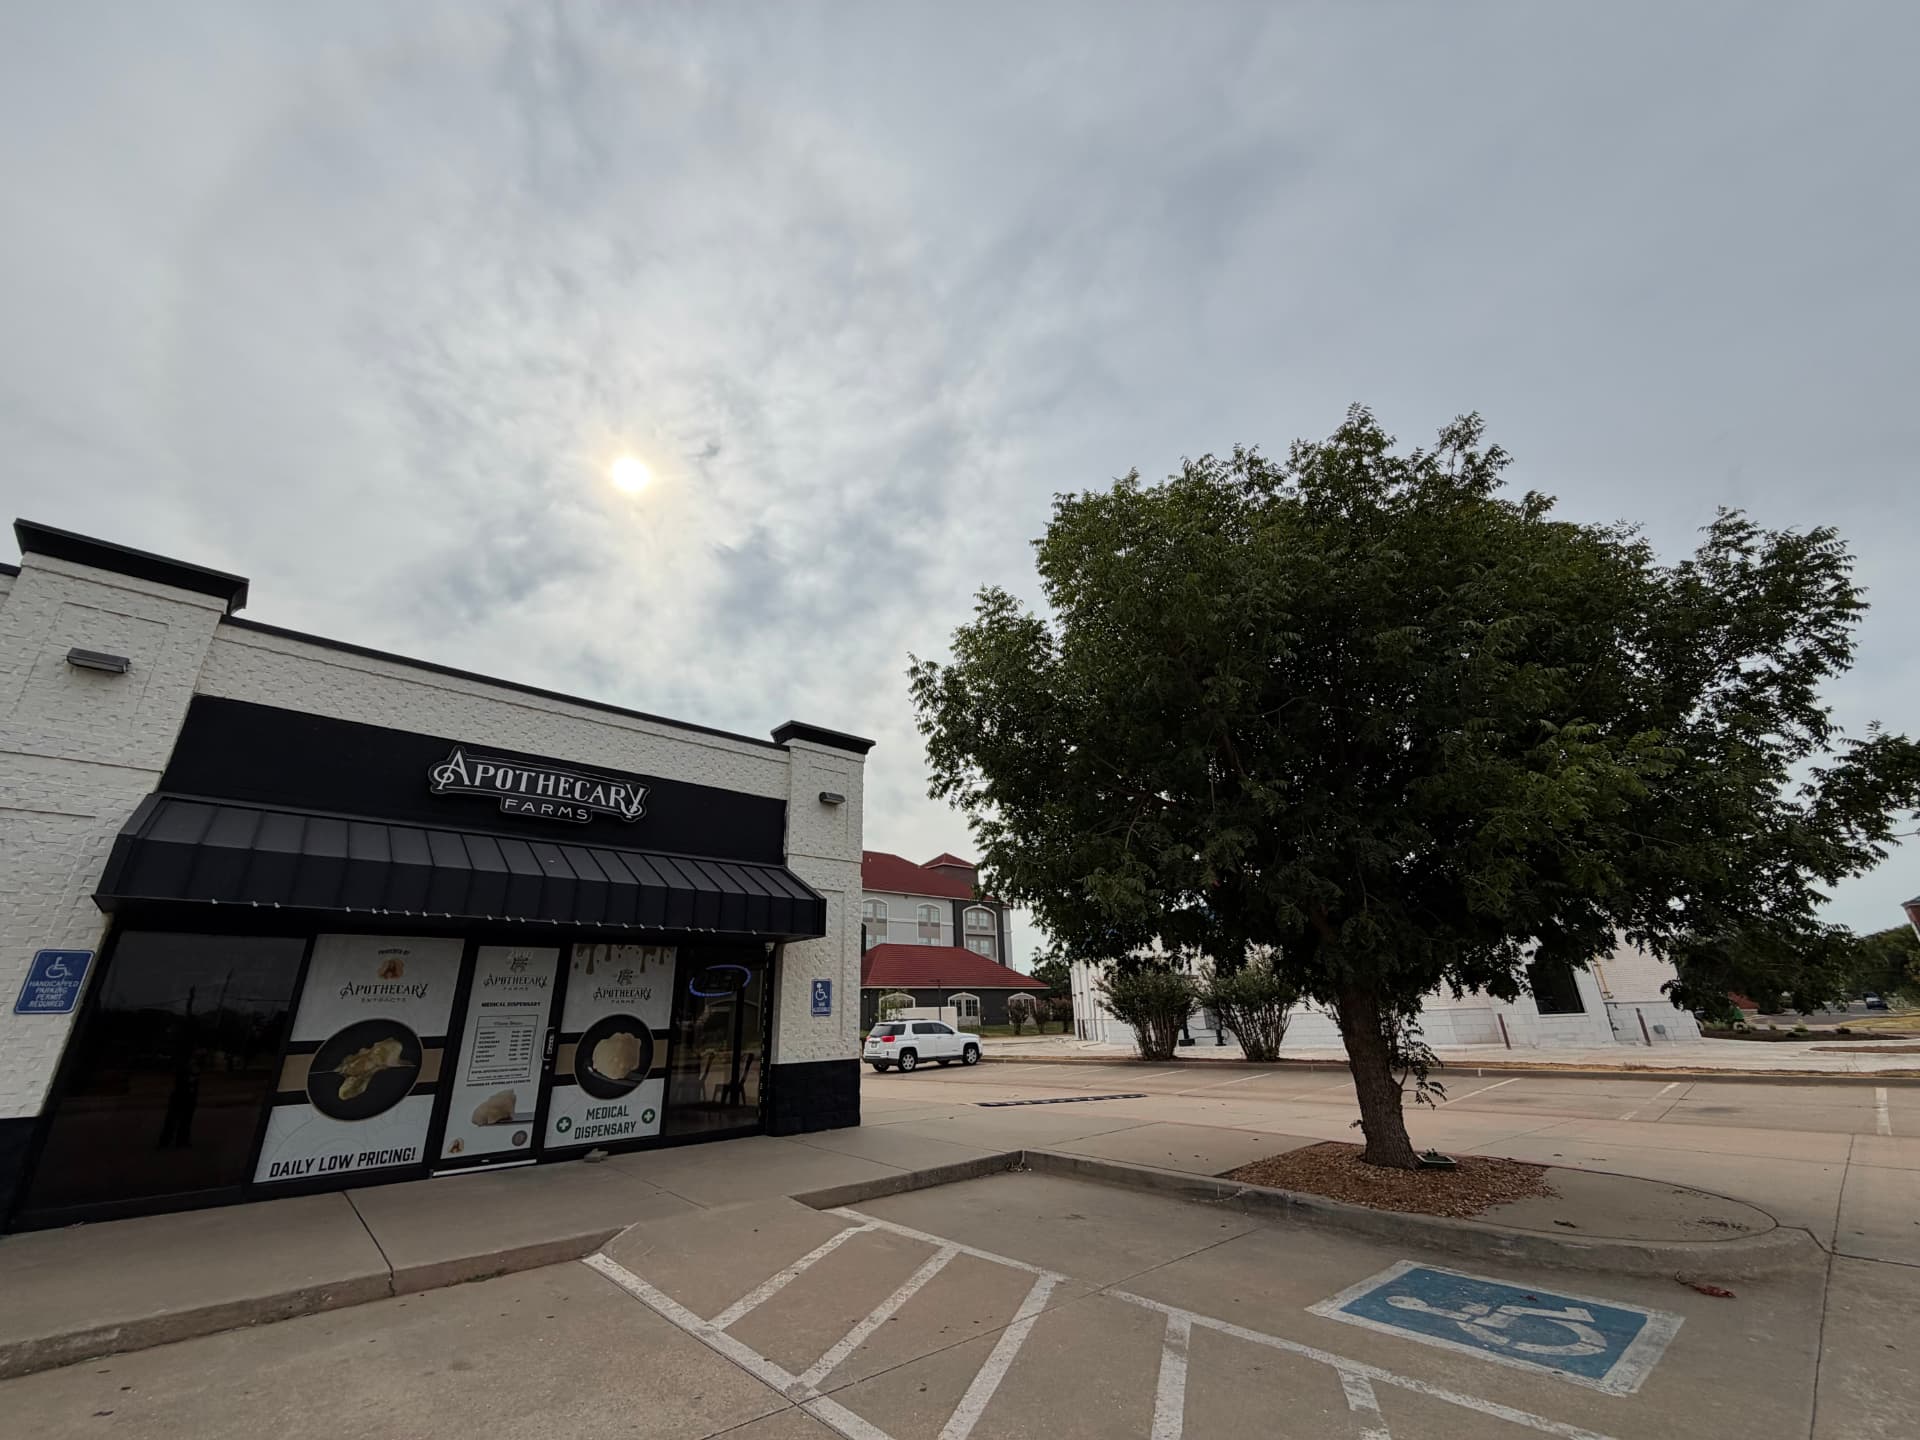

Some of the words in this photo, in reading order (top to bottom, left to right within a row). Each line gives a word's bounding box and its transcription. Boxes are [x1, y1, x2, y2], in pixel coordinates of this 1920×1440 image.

[433, 749, 647, 818] APOTHECARY
[504, 798, 589, 820] FARMS
[340, 980, 428, 999] APOTHECARY
[483, 972, 548, 989] APOTHECARY
[593, 986, 652, 1001] APOTHECARY
[585, 1105, 630, 1121] MEDICAL
[574, 1121, 637, 1140] DISPENSARY
[268, 1157, 316, 1178] DAILY
[318, 1153, 354, 1172] LOW
[357, 1147, 417, 1167] PRICING!
